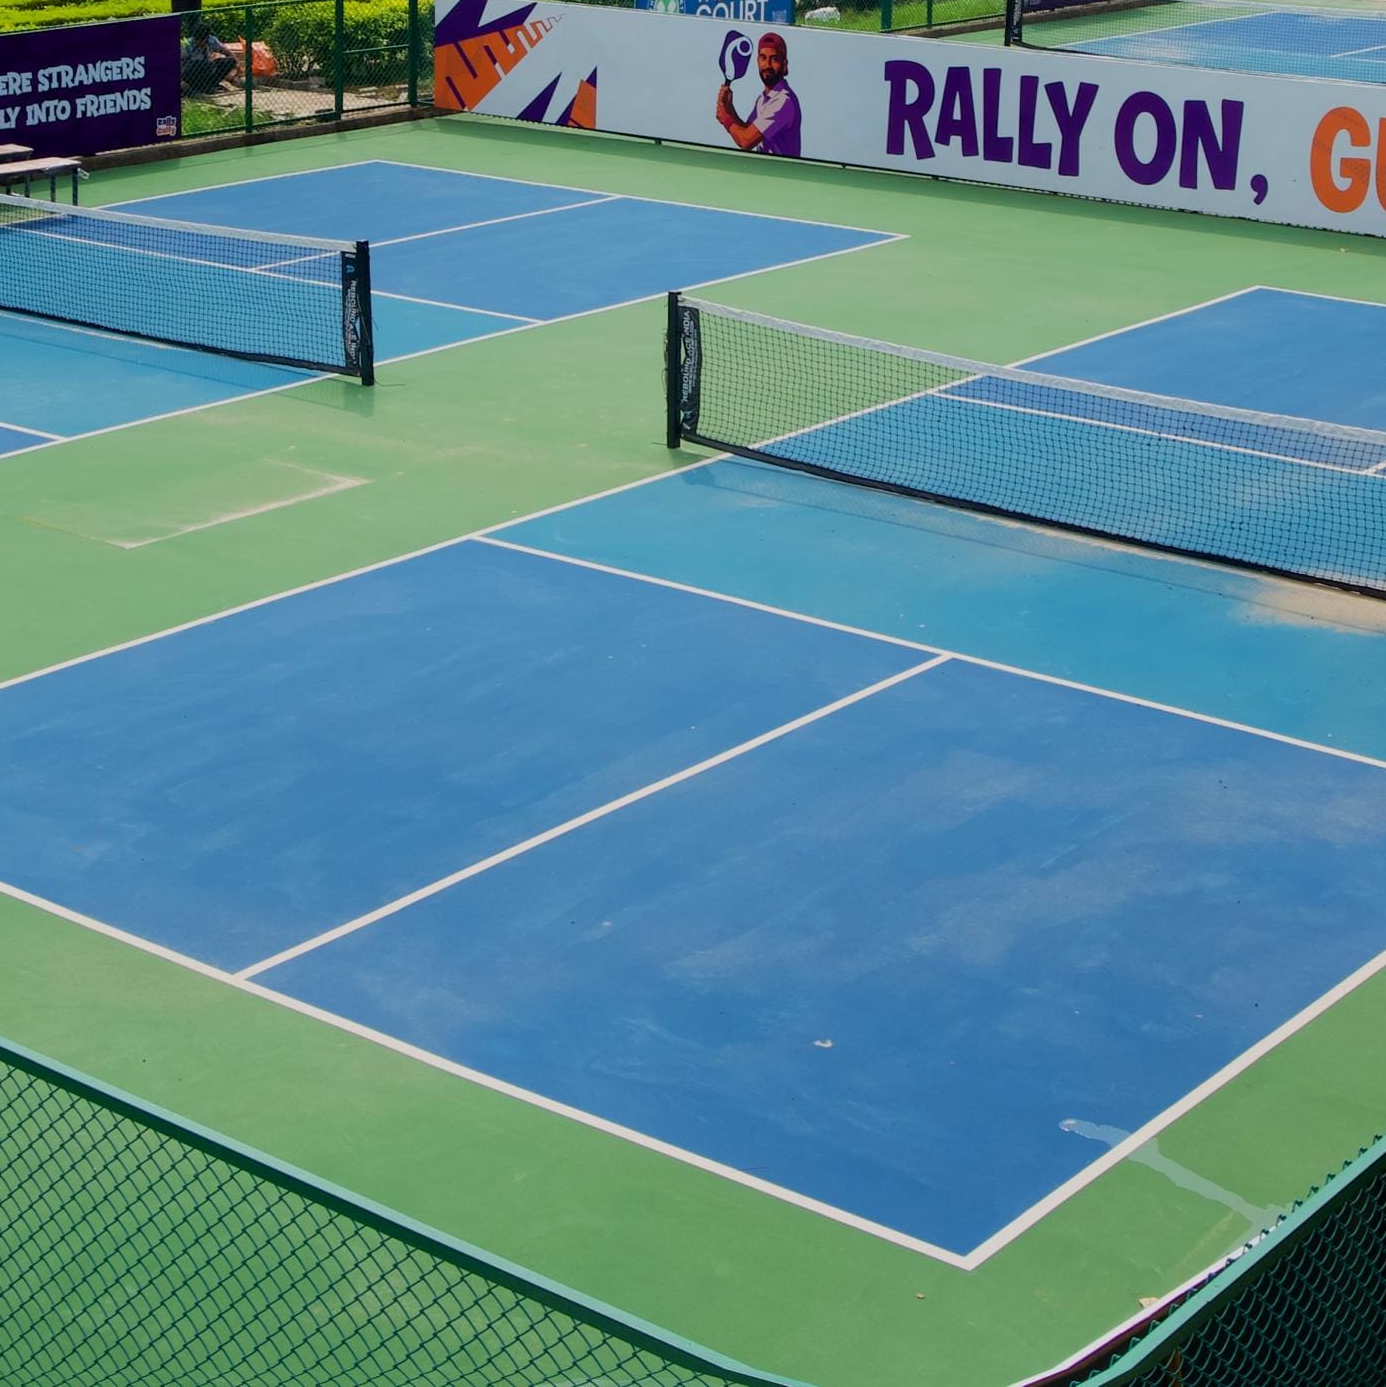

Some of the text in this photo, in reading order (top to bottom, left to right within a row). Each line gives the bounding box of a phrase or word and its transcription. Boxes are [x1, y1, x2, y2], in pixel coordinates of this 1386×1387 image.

[37, 56, 145, 93] STRANGERS
[26, 99, 71, 126] INTO
[76, 87, 152, 119] FRIENDS
[884, 60, 1099, 177] RALLY
[1114, 91, 1269, 205] ON,
